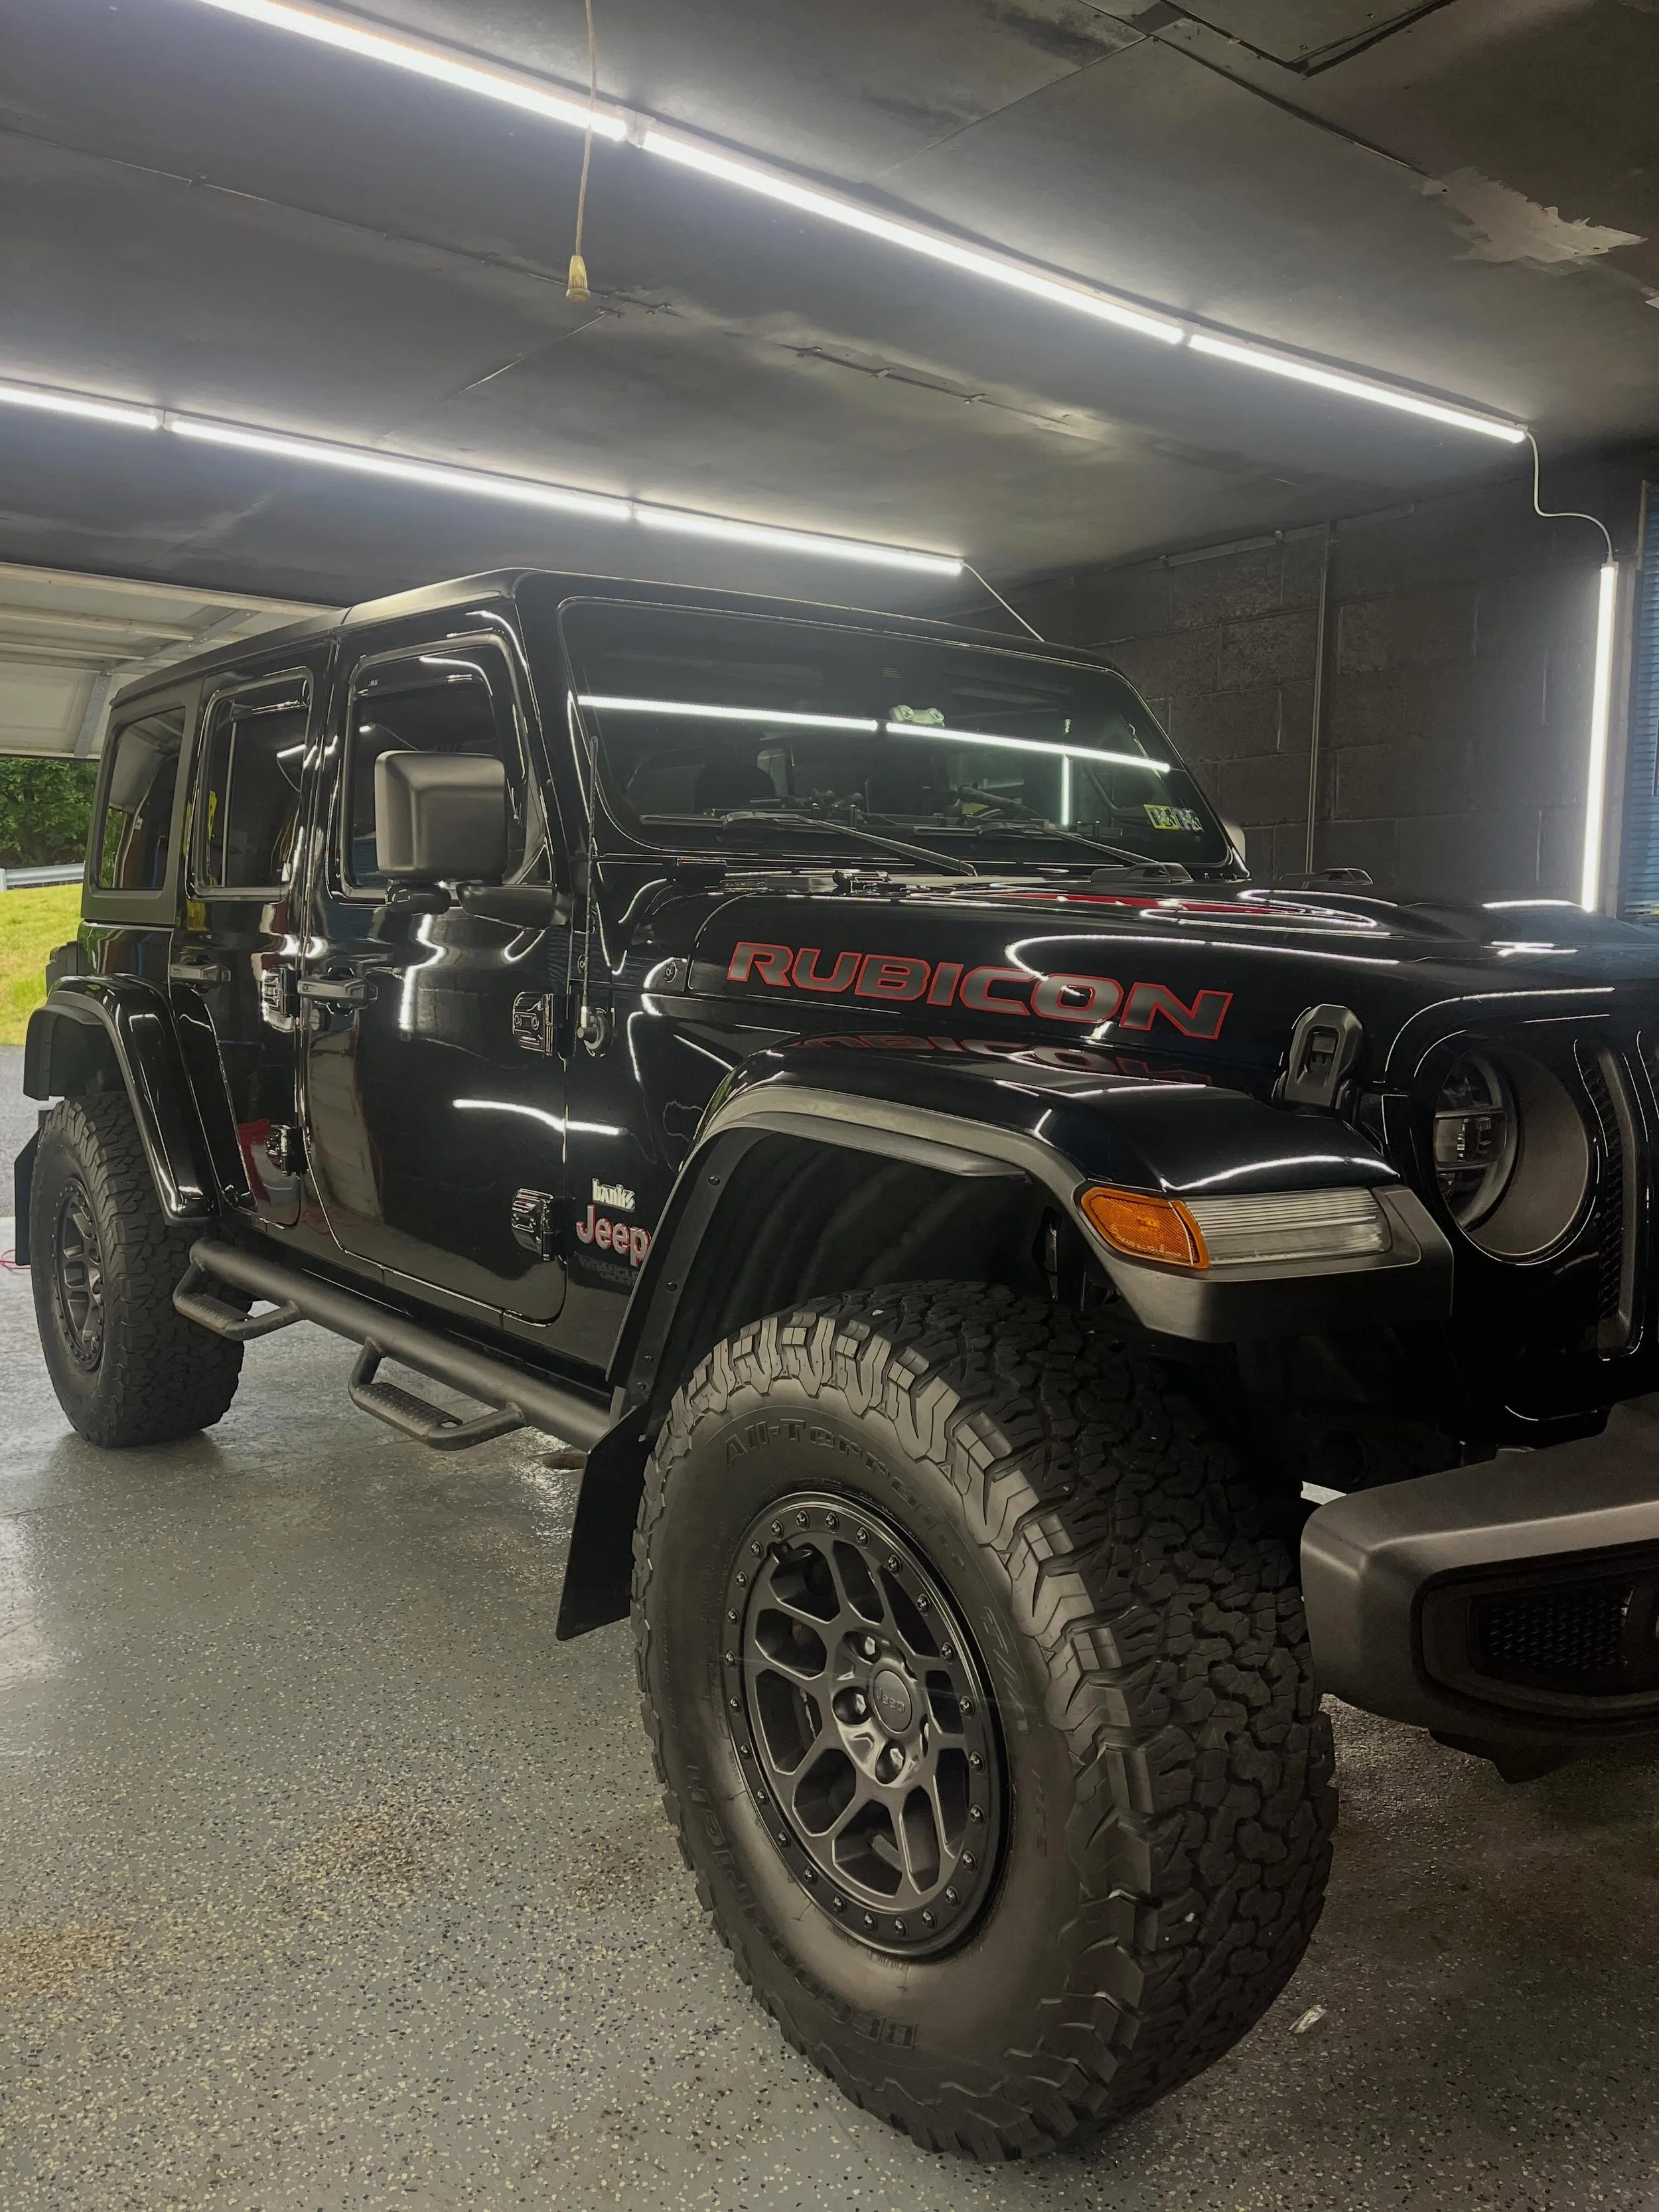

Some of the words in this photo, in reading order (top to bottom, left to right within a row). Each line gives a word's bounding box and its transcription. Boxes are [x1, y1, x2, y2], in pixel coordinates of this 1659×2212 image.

[727, 941, 1234, 1041] RUBICON
[576, 1203, 652, 1268] Jeep
[875, 1688, 906, 1715] Jeep
